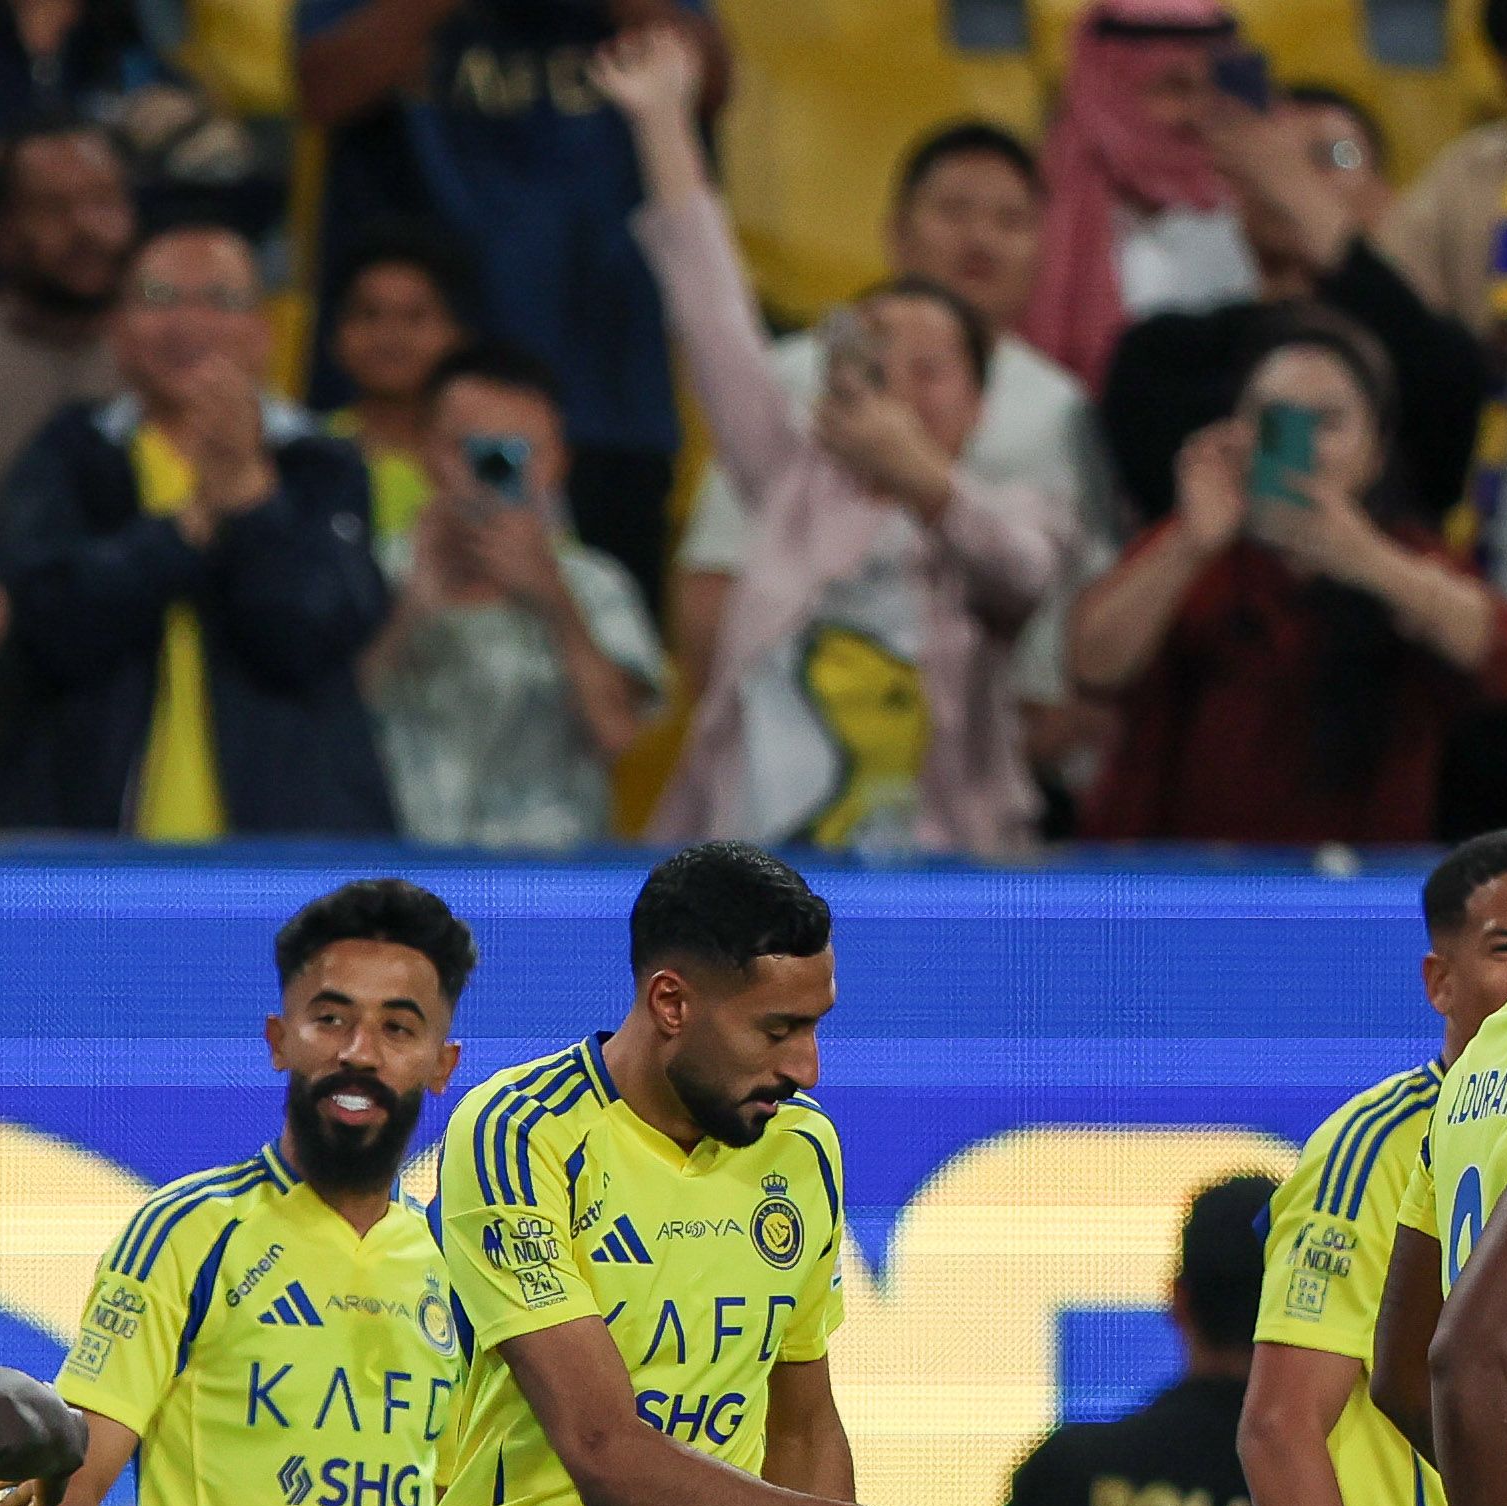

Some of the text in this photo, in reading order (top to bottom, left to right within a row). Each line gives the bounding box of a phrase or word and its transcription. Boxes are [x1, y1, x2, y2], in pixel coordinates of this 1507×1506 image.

[656, 1218, 745, 1241] AROYA
[605, 1295, 796, 1365] AFD
[635, 1390, 747, 1446] SHG
